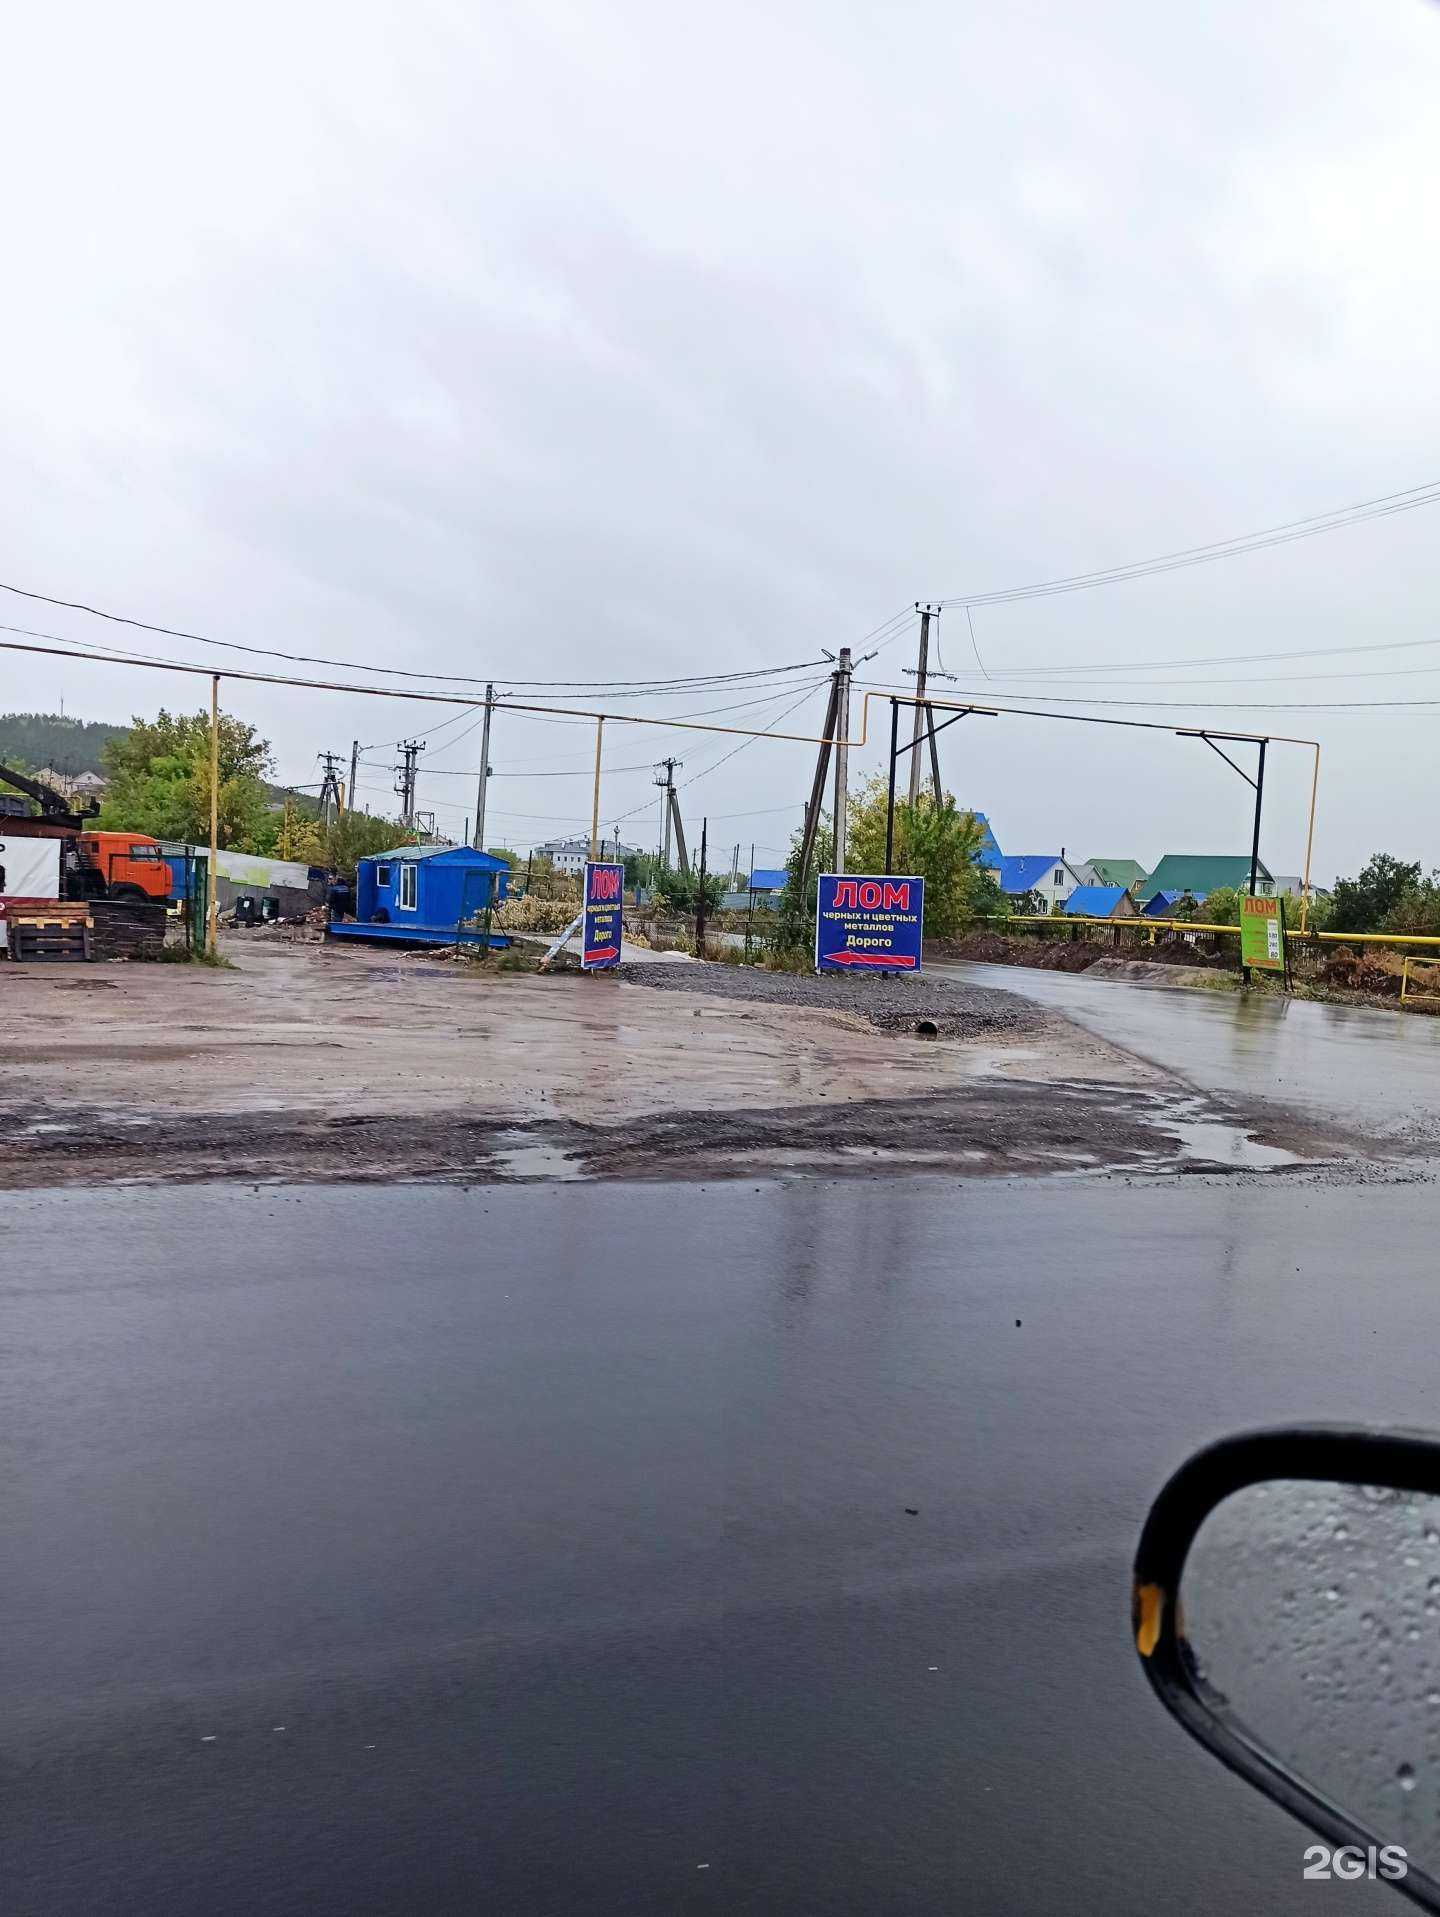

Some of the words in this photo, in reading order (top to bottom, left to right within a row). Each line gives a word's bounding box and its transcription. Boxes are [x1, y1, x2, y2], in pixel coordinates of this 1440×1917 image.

[590, 869, 621, 899] ЛОМ
[832, 881, 910, 911] ЛОМ
[1244, 897, 1277, 913] ЛОМ
[822, 911, 861, 920] черных
[872, 913, 918, 922] цветных
[844, 923, 895, 932] металлов
[846, 935, 892, 948] Дорого
